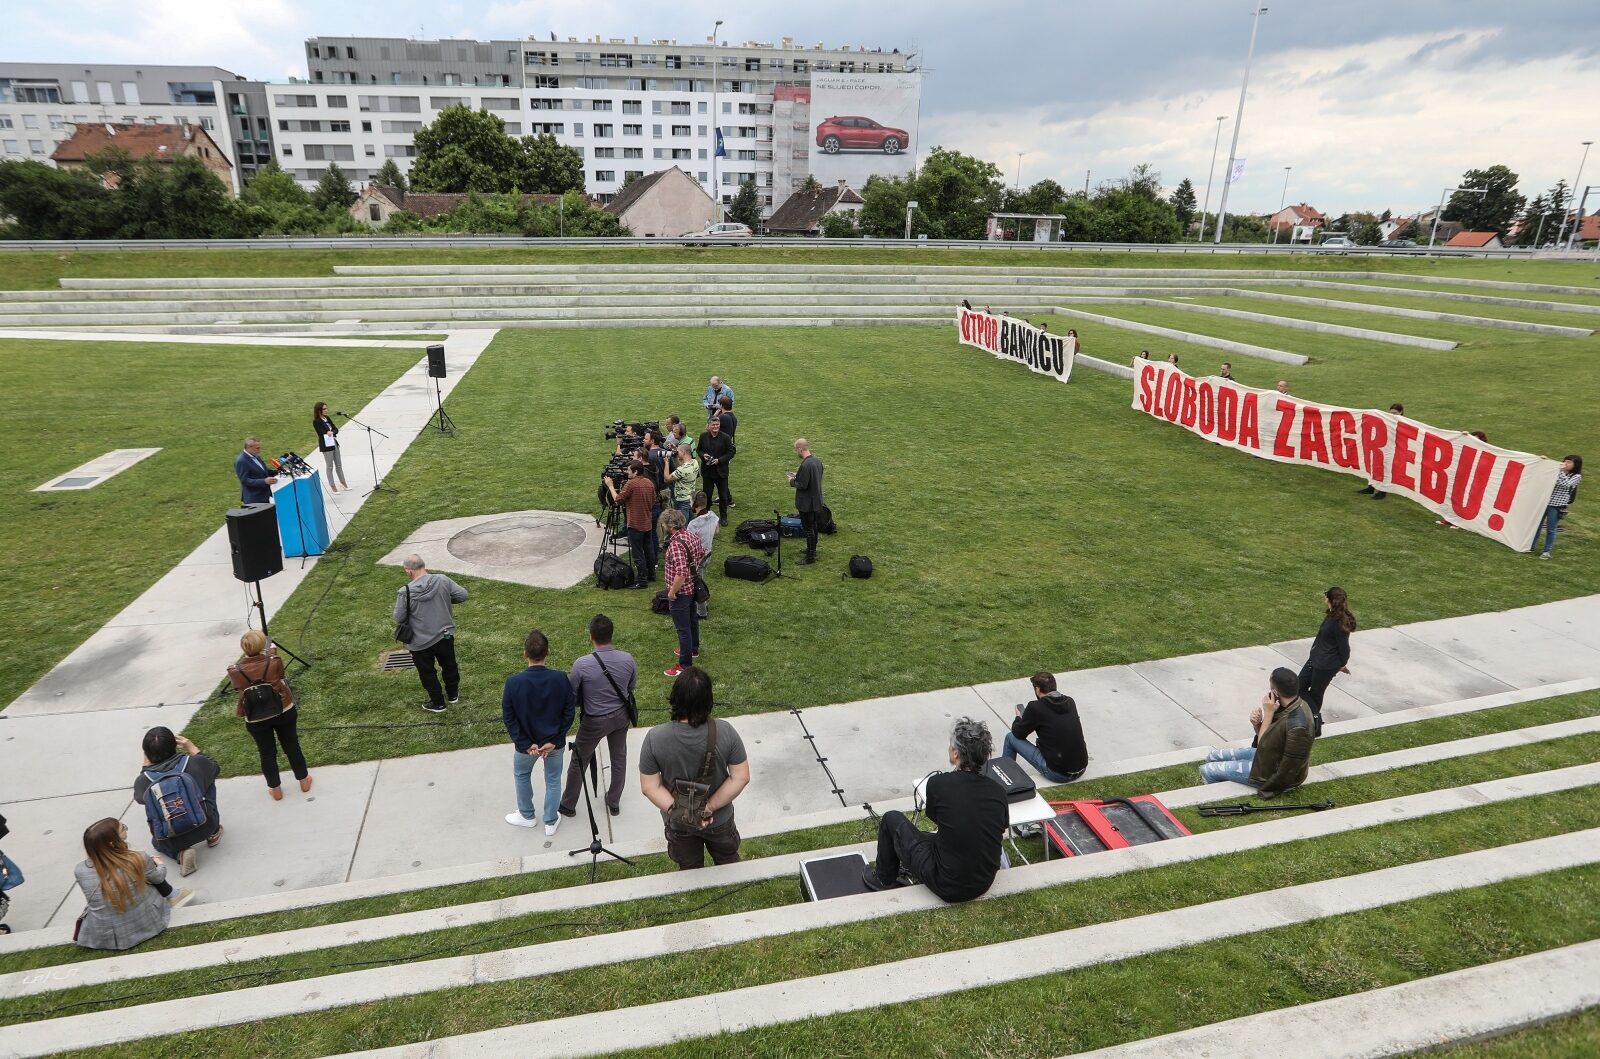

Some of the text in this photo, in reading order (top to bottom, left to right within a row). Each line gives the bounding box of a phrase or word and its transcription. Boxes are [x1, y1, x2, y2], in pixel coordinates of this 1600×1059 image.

[961, 310, 998, 352] OTPOR
[1139, 364, 1525, 532] SLOBODA ZAGREBU!
